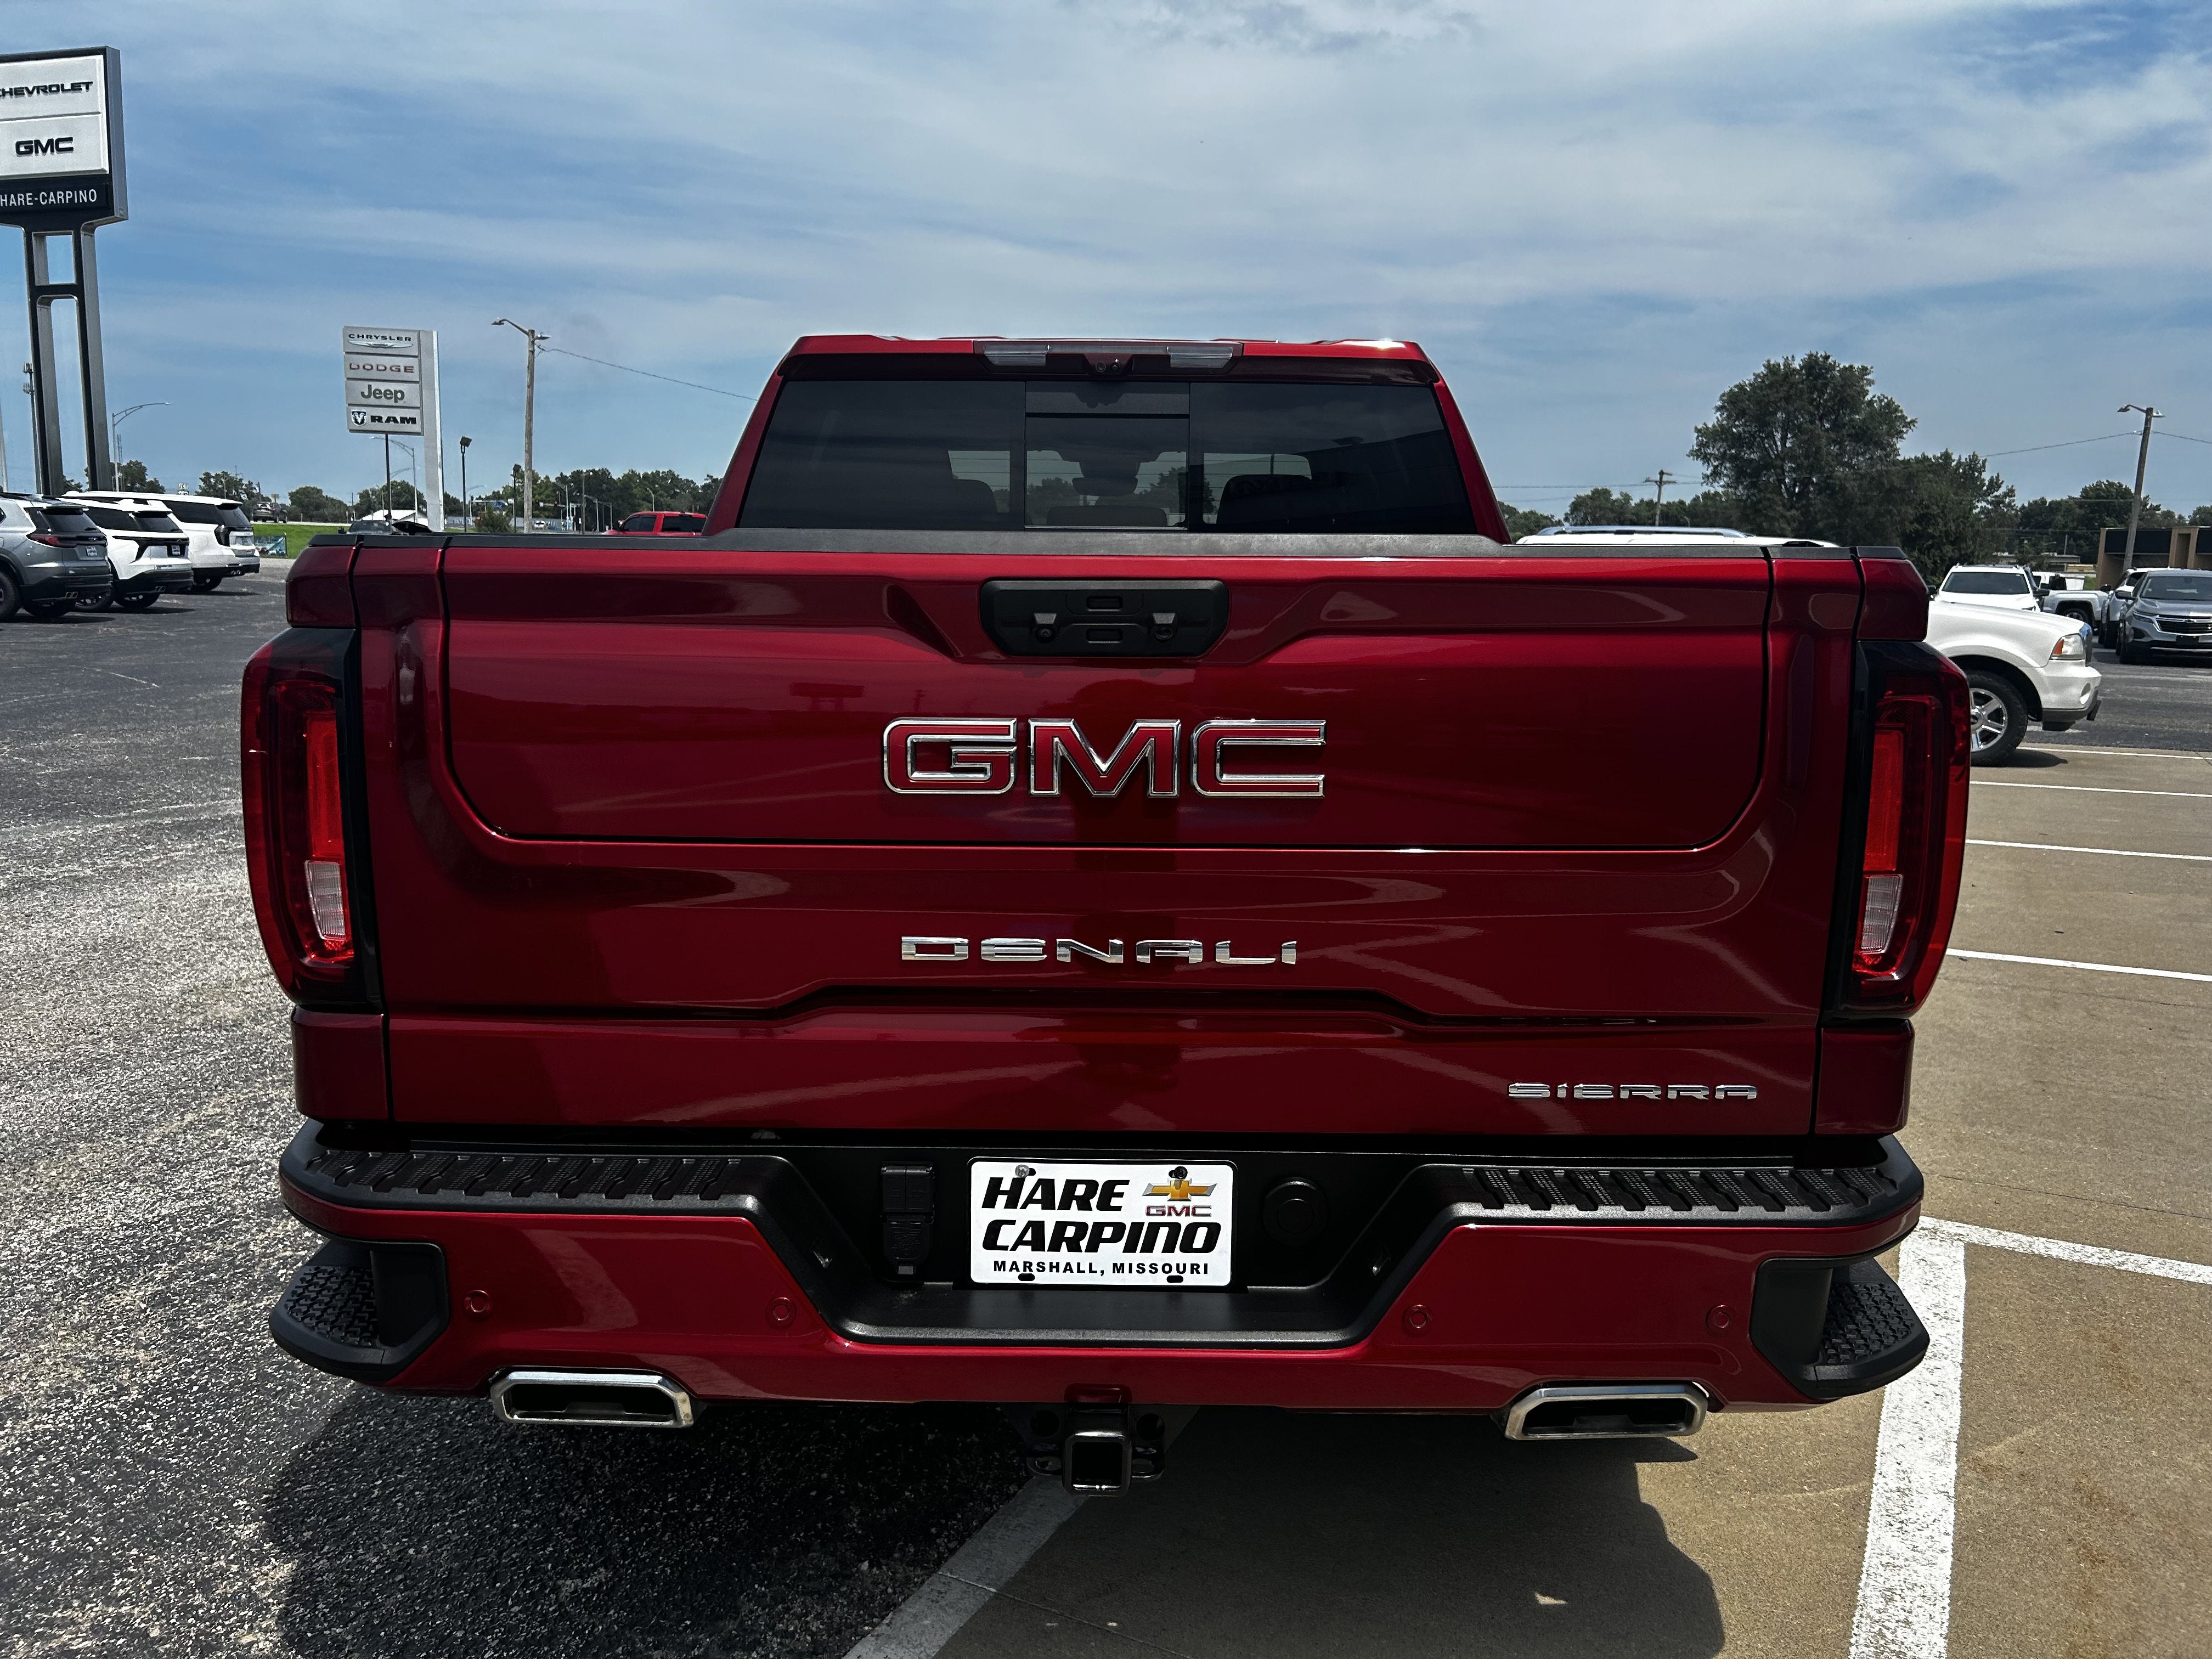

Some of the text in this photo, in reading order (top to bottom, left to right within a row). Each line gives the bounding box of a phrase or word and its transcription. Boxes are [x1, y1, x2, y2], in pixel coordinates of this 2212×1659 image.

[0, 81, 93, 98] HEVROLET
[15, 137, 74, 155] GMC
[0, 188, 98, 207] HARE-CARPINO
[348, 334, 411, 342] CHRYSLER
[349, 363, 414, 374] DODGE
[360, 384, 405, 403] Jeep
[370, 415, 417, 425] RAM
[883, 717, 1327, 798] GMC
[901, 936, 1297, 964] DENALI
[1508, 1082, 1757, 1100] SIERRA
[981, 1177, 1130, 1211] HARE
[1145, 1205, 1212, 1217] GMC
[981, 1219, 1222, 1254] CARPINO
[994, 1260, 1209, 1277] MARSHALL, MISSOURI
